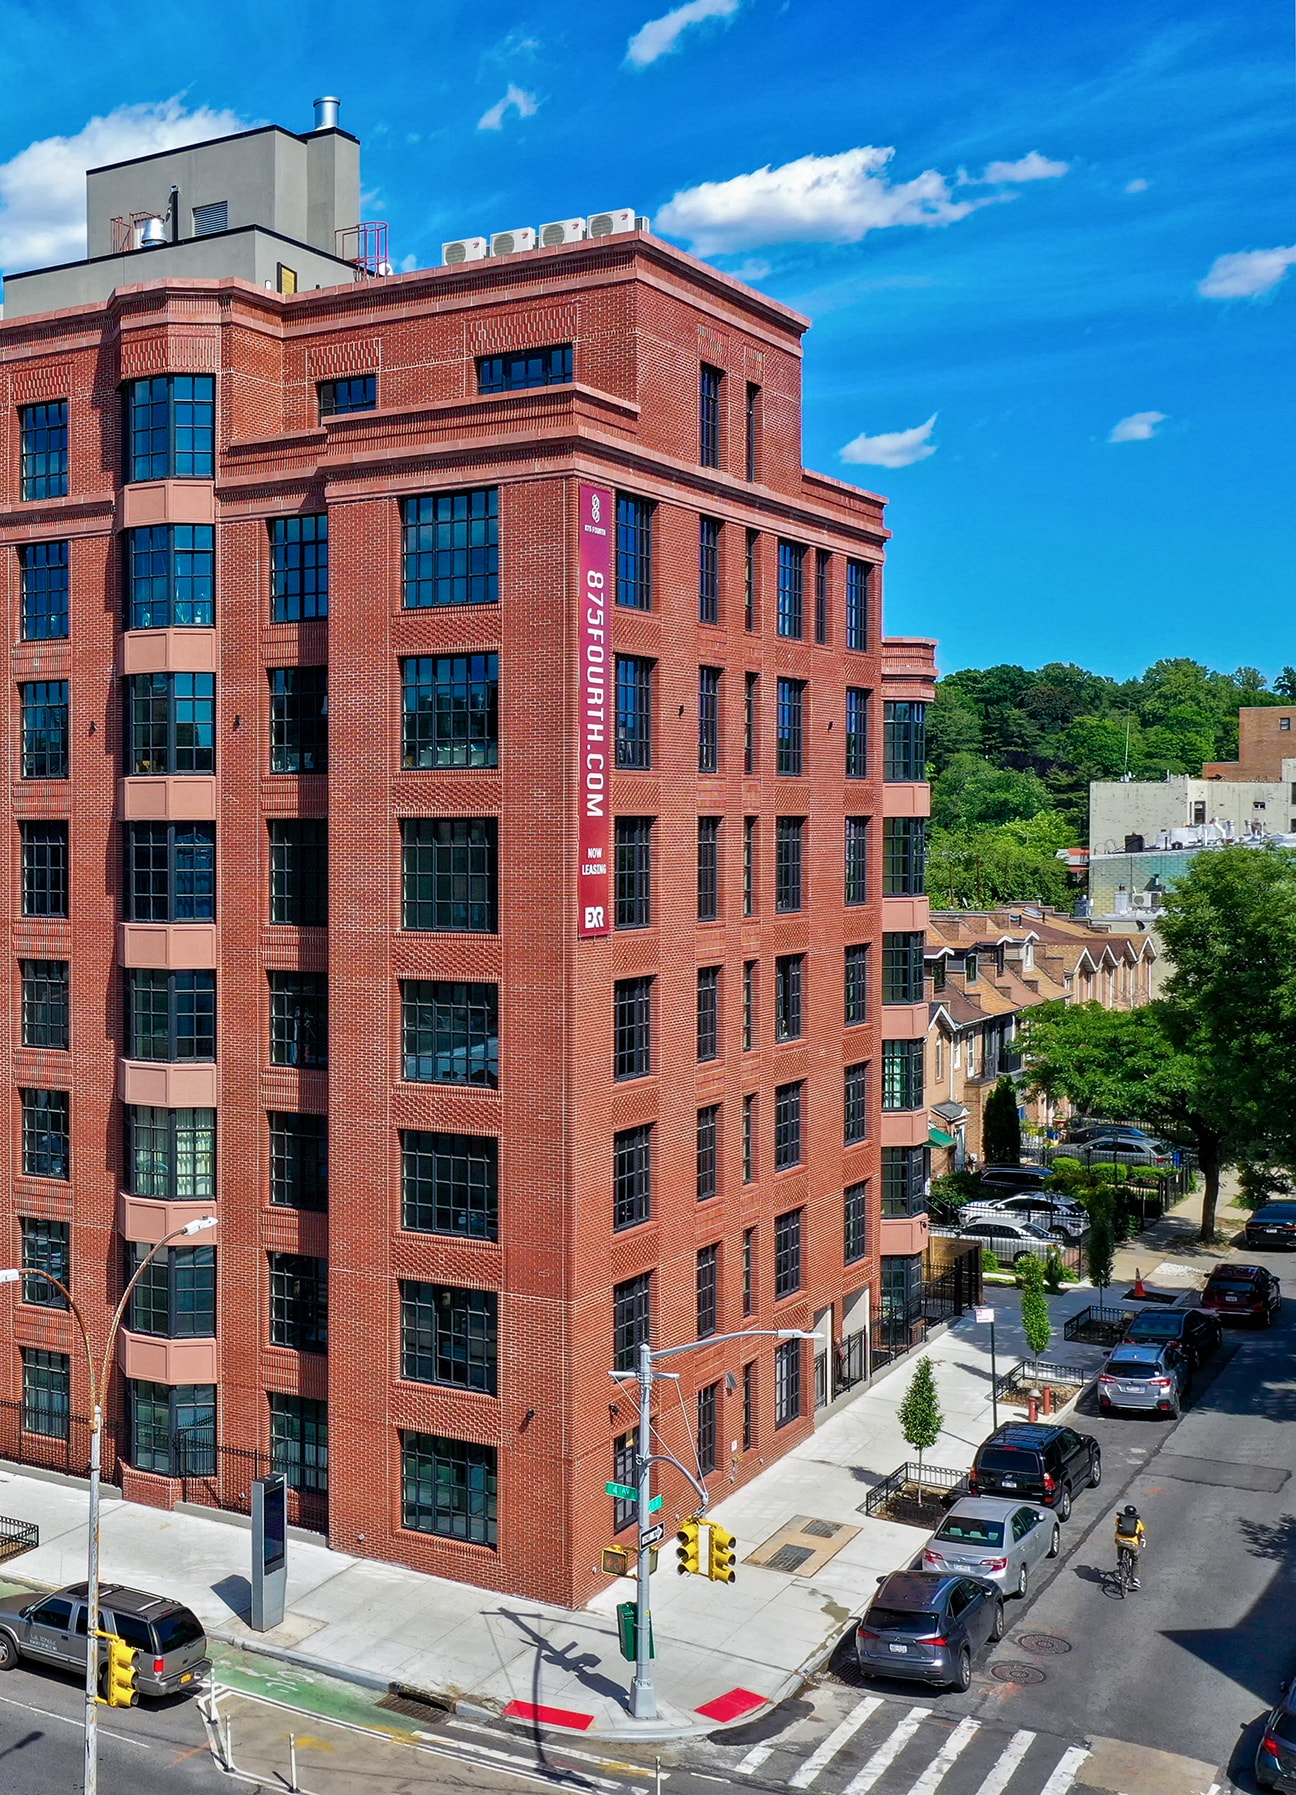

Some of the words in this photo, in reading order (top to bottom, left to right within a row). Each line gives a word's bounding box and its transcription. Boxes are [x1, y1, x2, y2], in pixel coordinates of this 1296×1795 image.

[587, 570, 604, 817] 875FOURTH.COM
[587, 847, 602, 858] NOW
[581, 864, 607, 876] LEASING
[612, 1486, 618, 1494] 4
